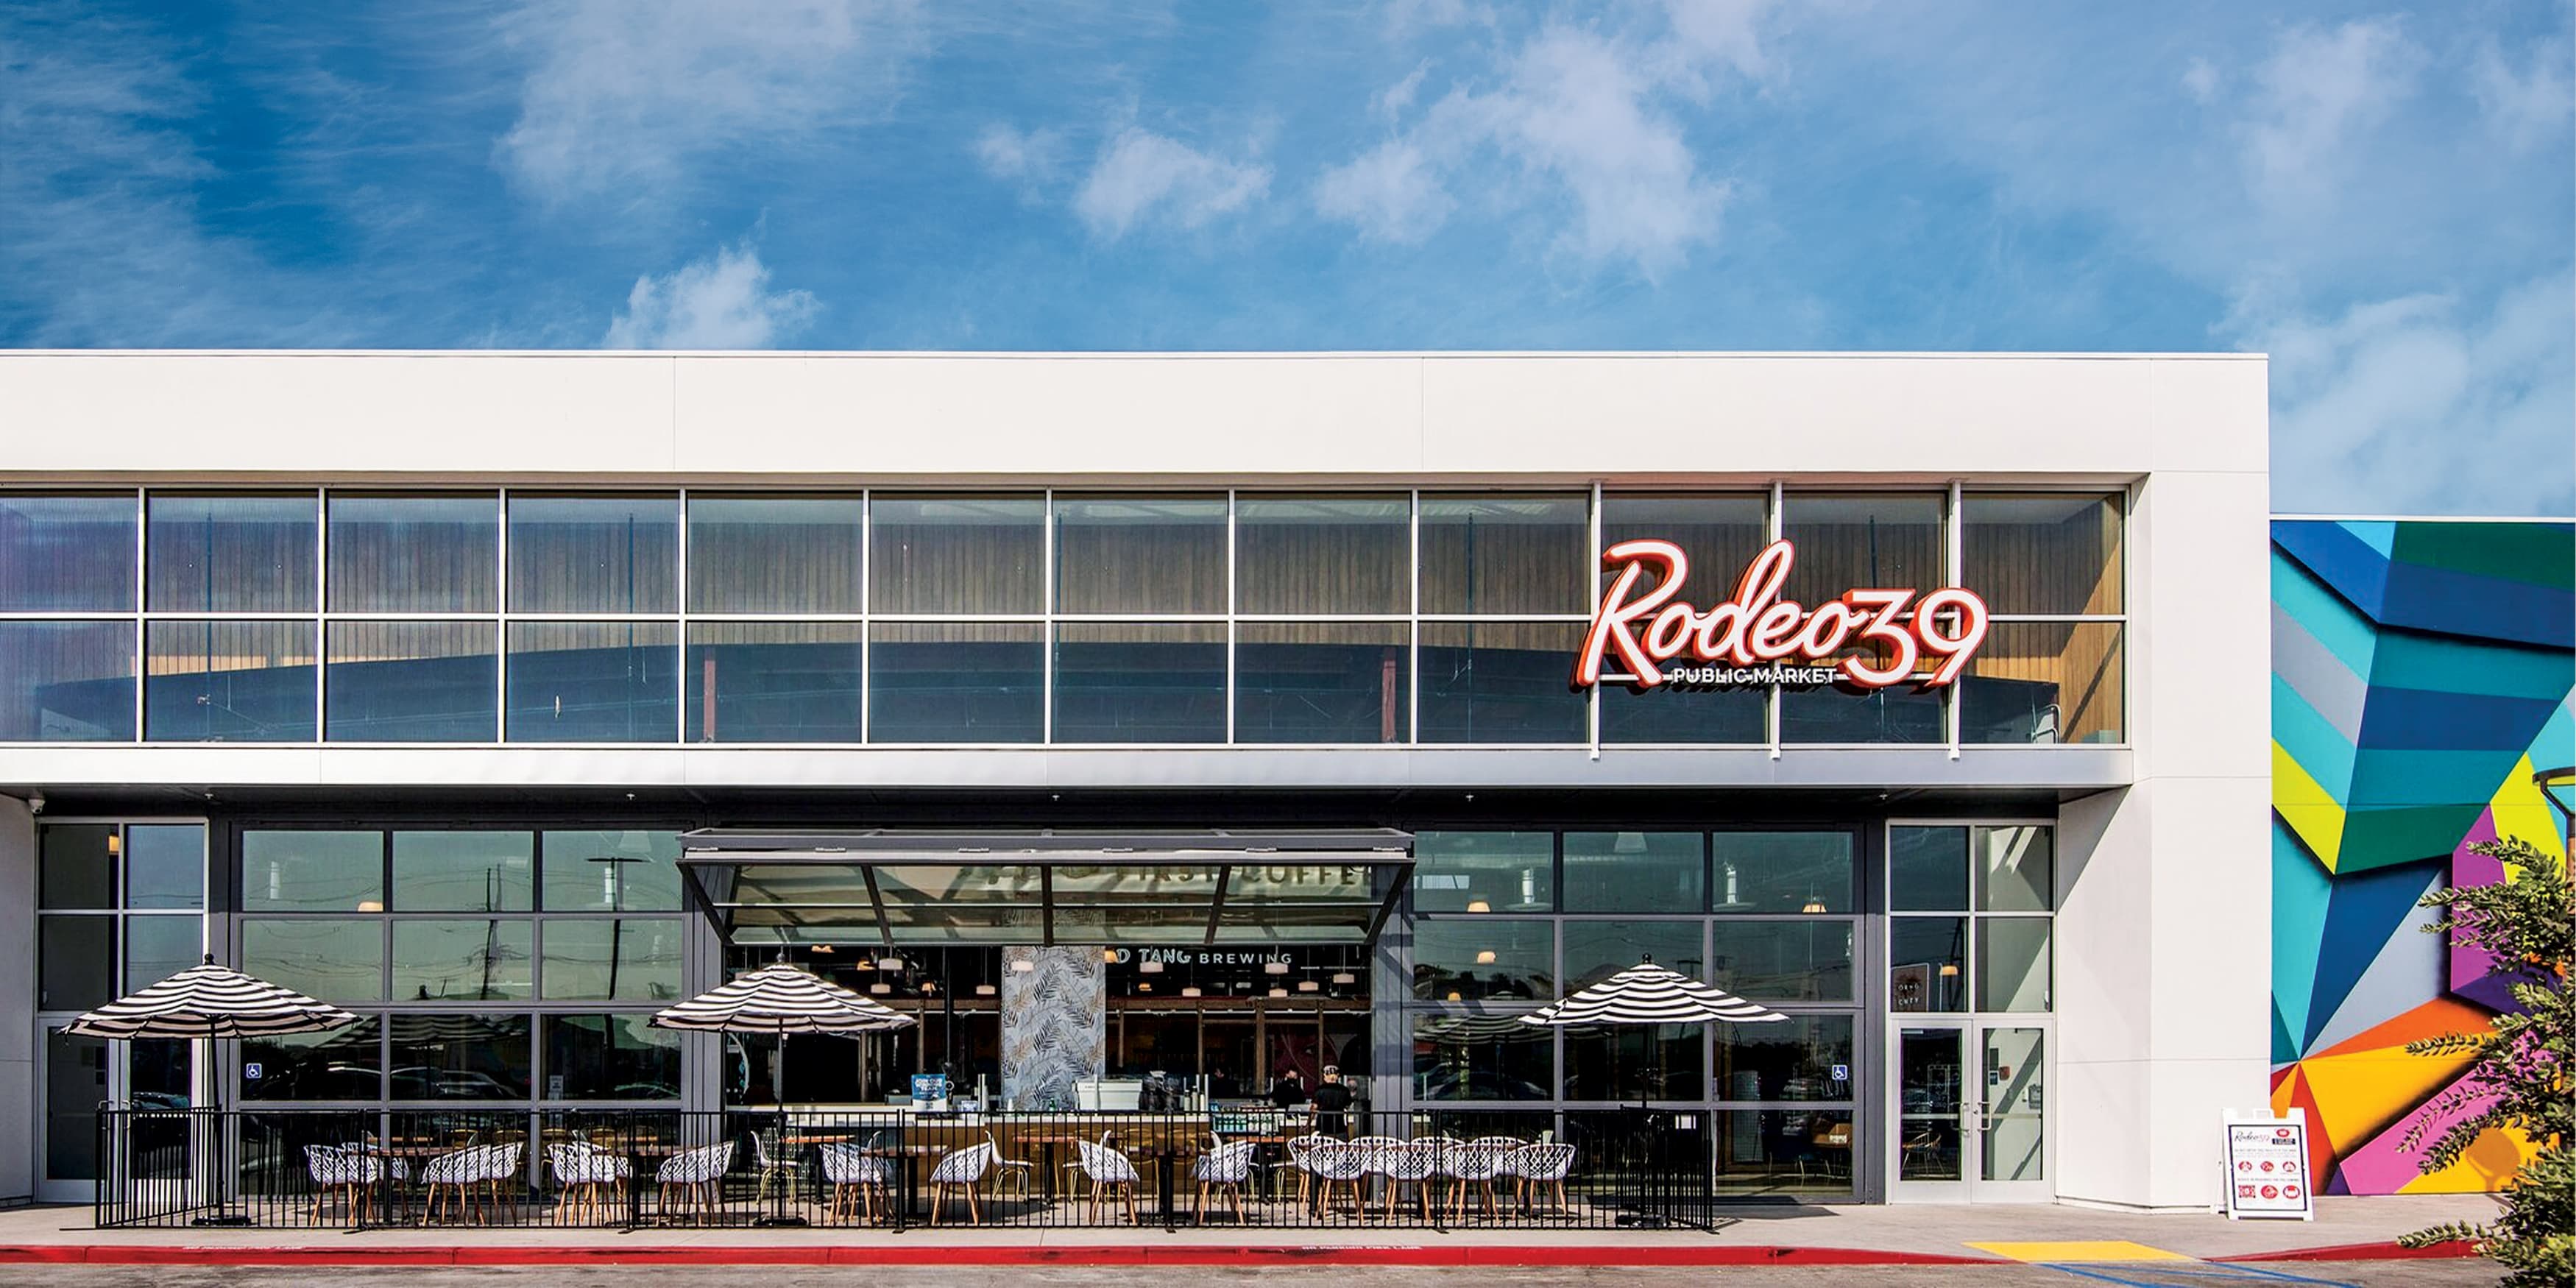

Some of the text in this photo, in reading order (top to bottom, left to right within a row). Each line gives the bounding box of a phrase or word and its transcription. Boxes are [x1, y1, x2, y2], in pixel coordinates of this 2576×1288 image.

[1578, 539, 1989, 689] Rodeo39
[1674, 668, 1838, 684] PUBLIC MARKET
[1139, 948, 1192, 964] TANG
[1200, 952, 1292, 964] BREWING
